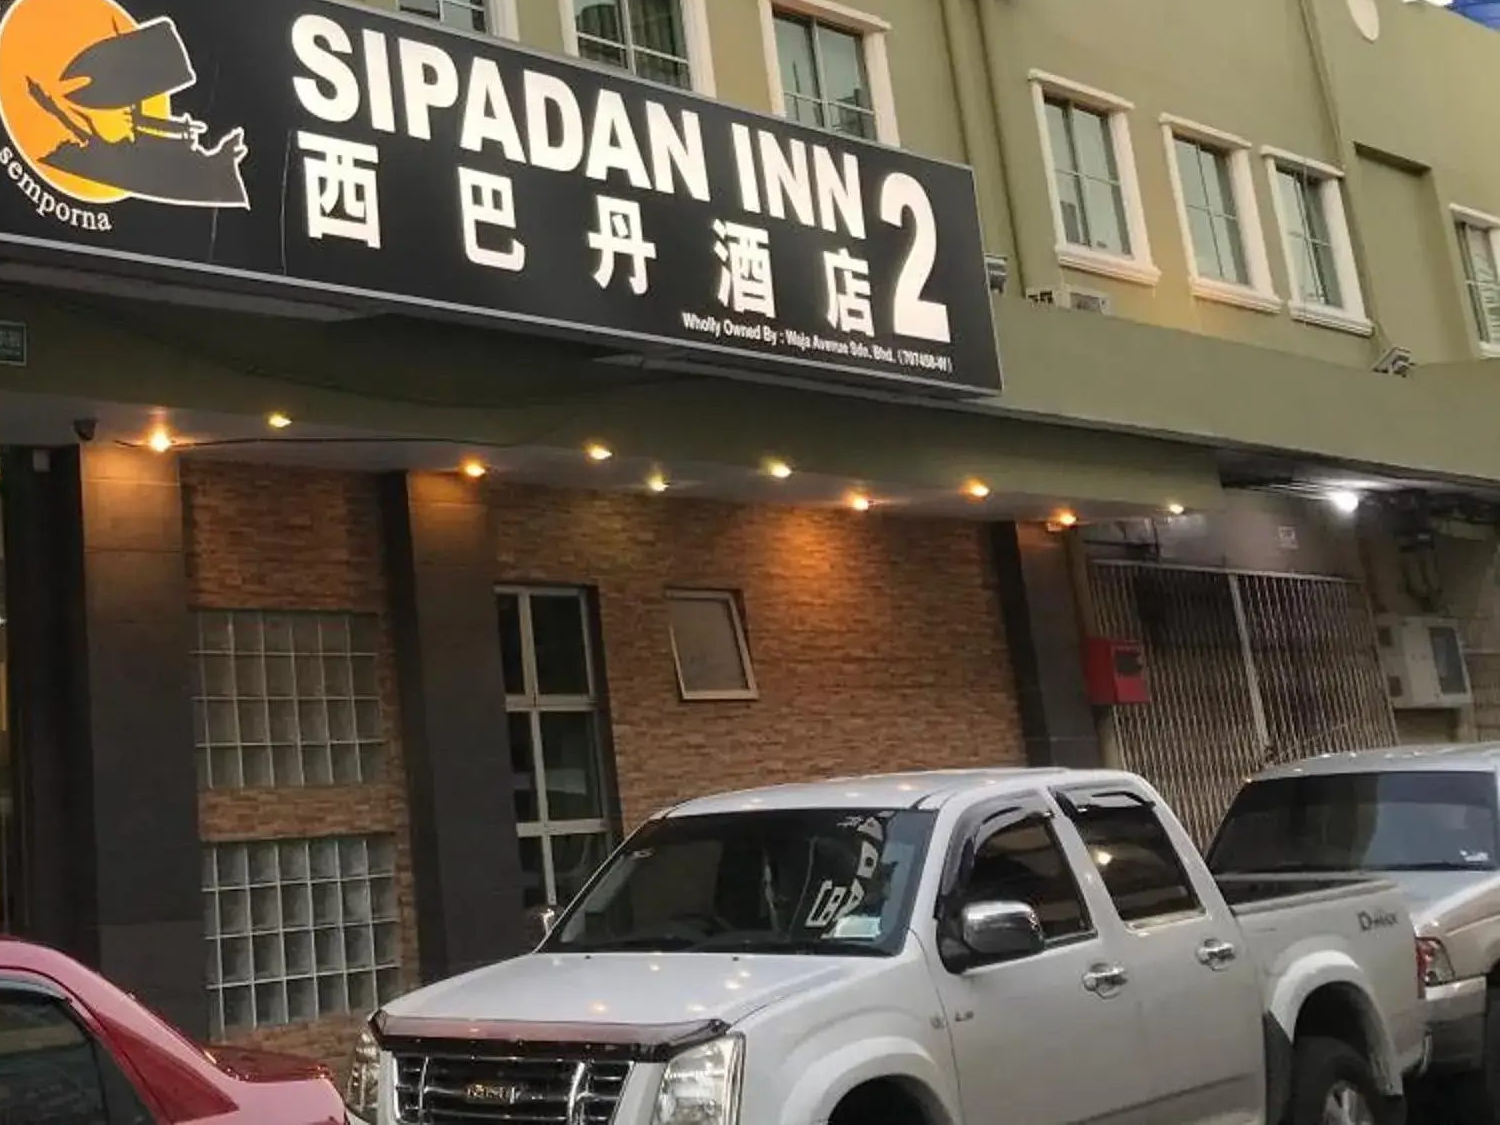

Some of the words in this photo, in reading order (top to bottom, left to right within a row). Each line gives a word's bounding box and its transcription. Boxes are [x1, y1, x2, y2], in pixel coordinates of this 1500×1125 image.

[291, 14, 709, 203] SIPADAN
[732, 121, 867, 240] INN
[879, 172, 951, 344] 2
[681, 312, 721, 337] Wholly
[724, 318, 762, 341] Owned
[762, 325, 777, 347] By
